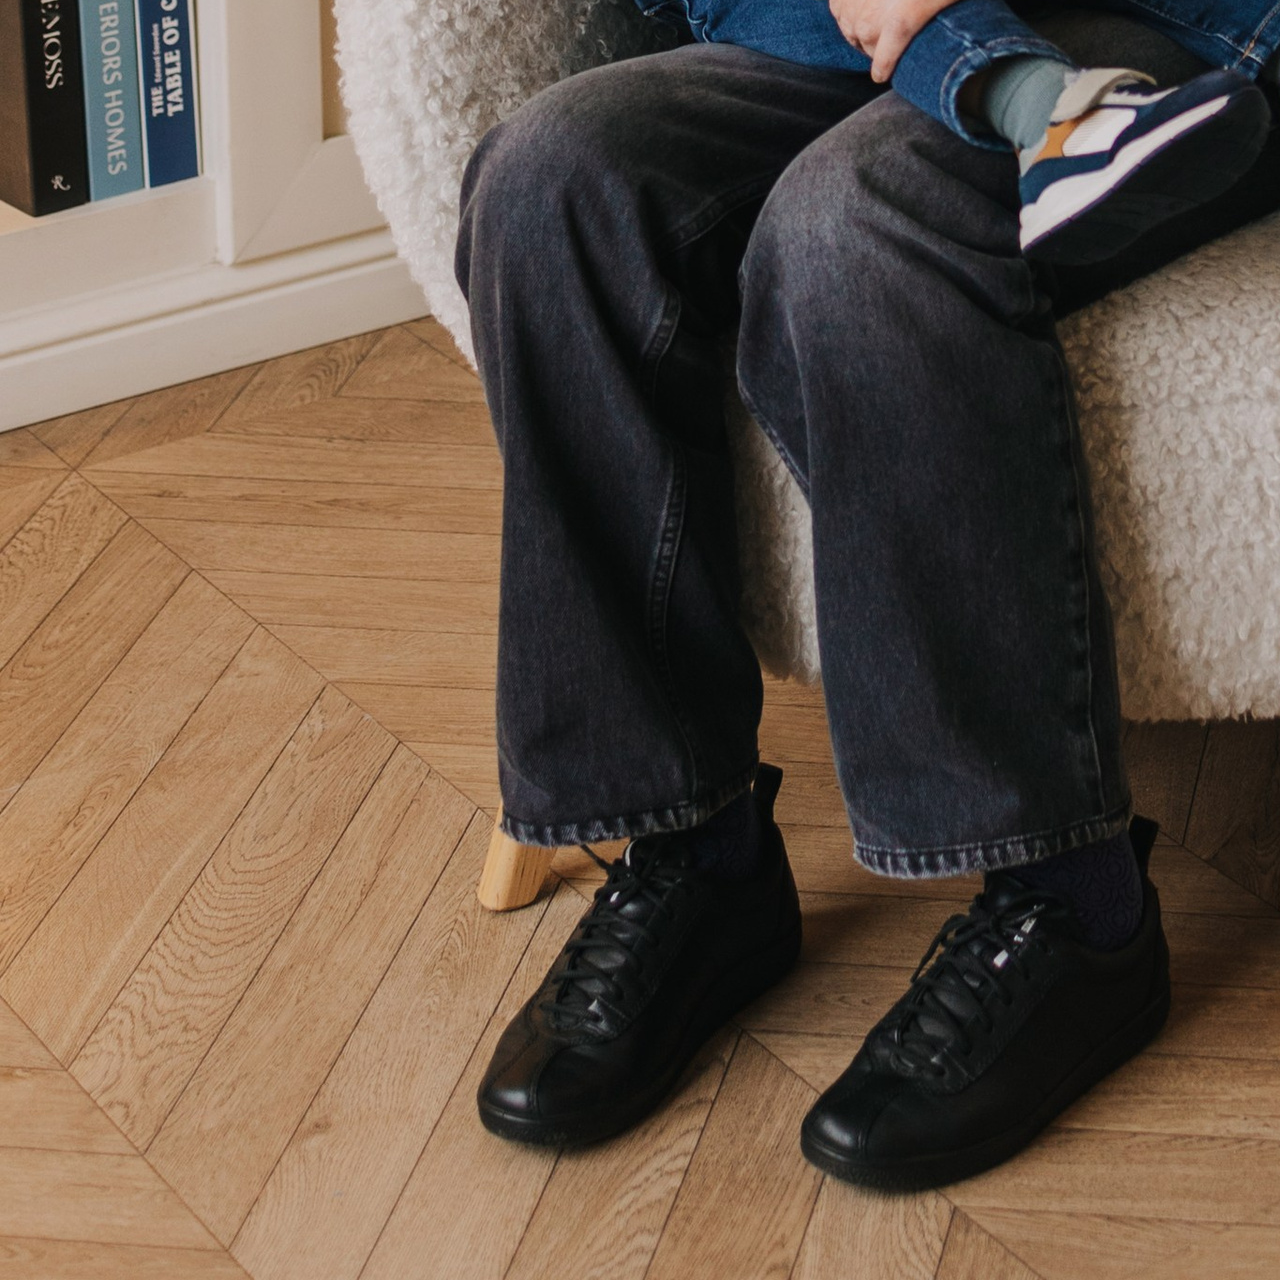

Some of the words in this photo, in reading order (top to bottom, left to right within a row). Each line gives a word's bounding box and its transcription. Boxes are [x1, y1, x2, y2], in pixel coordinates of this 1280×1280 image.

[162, 15, 179, 45] OF
[151, 86, 164, 117] THE
[164, 49, 184, 117] TABLE
[105, 90, 128, 176] HOMES
